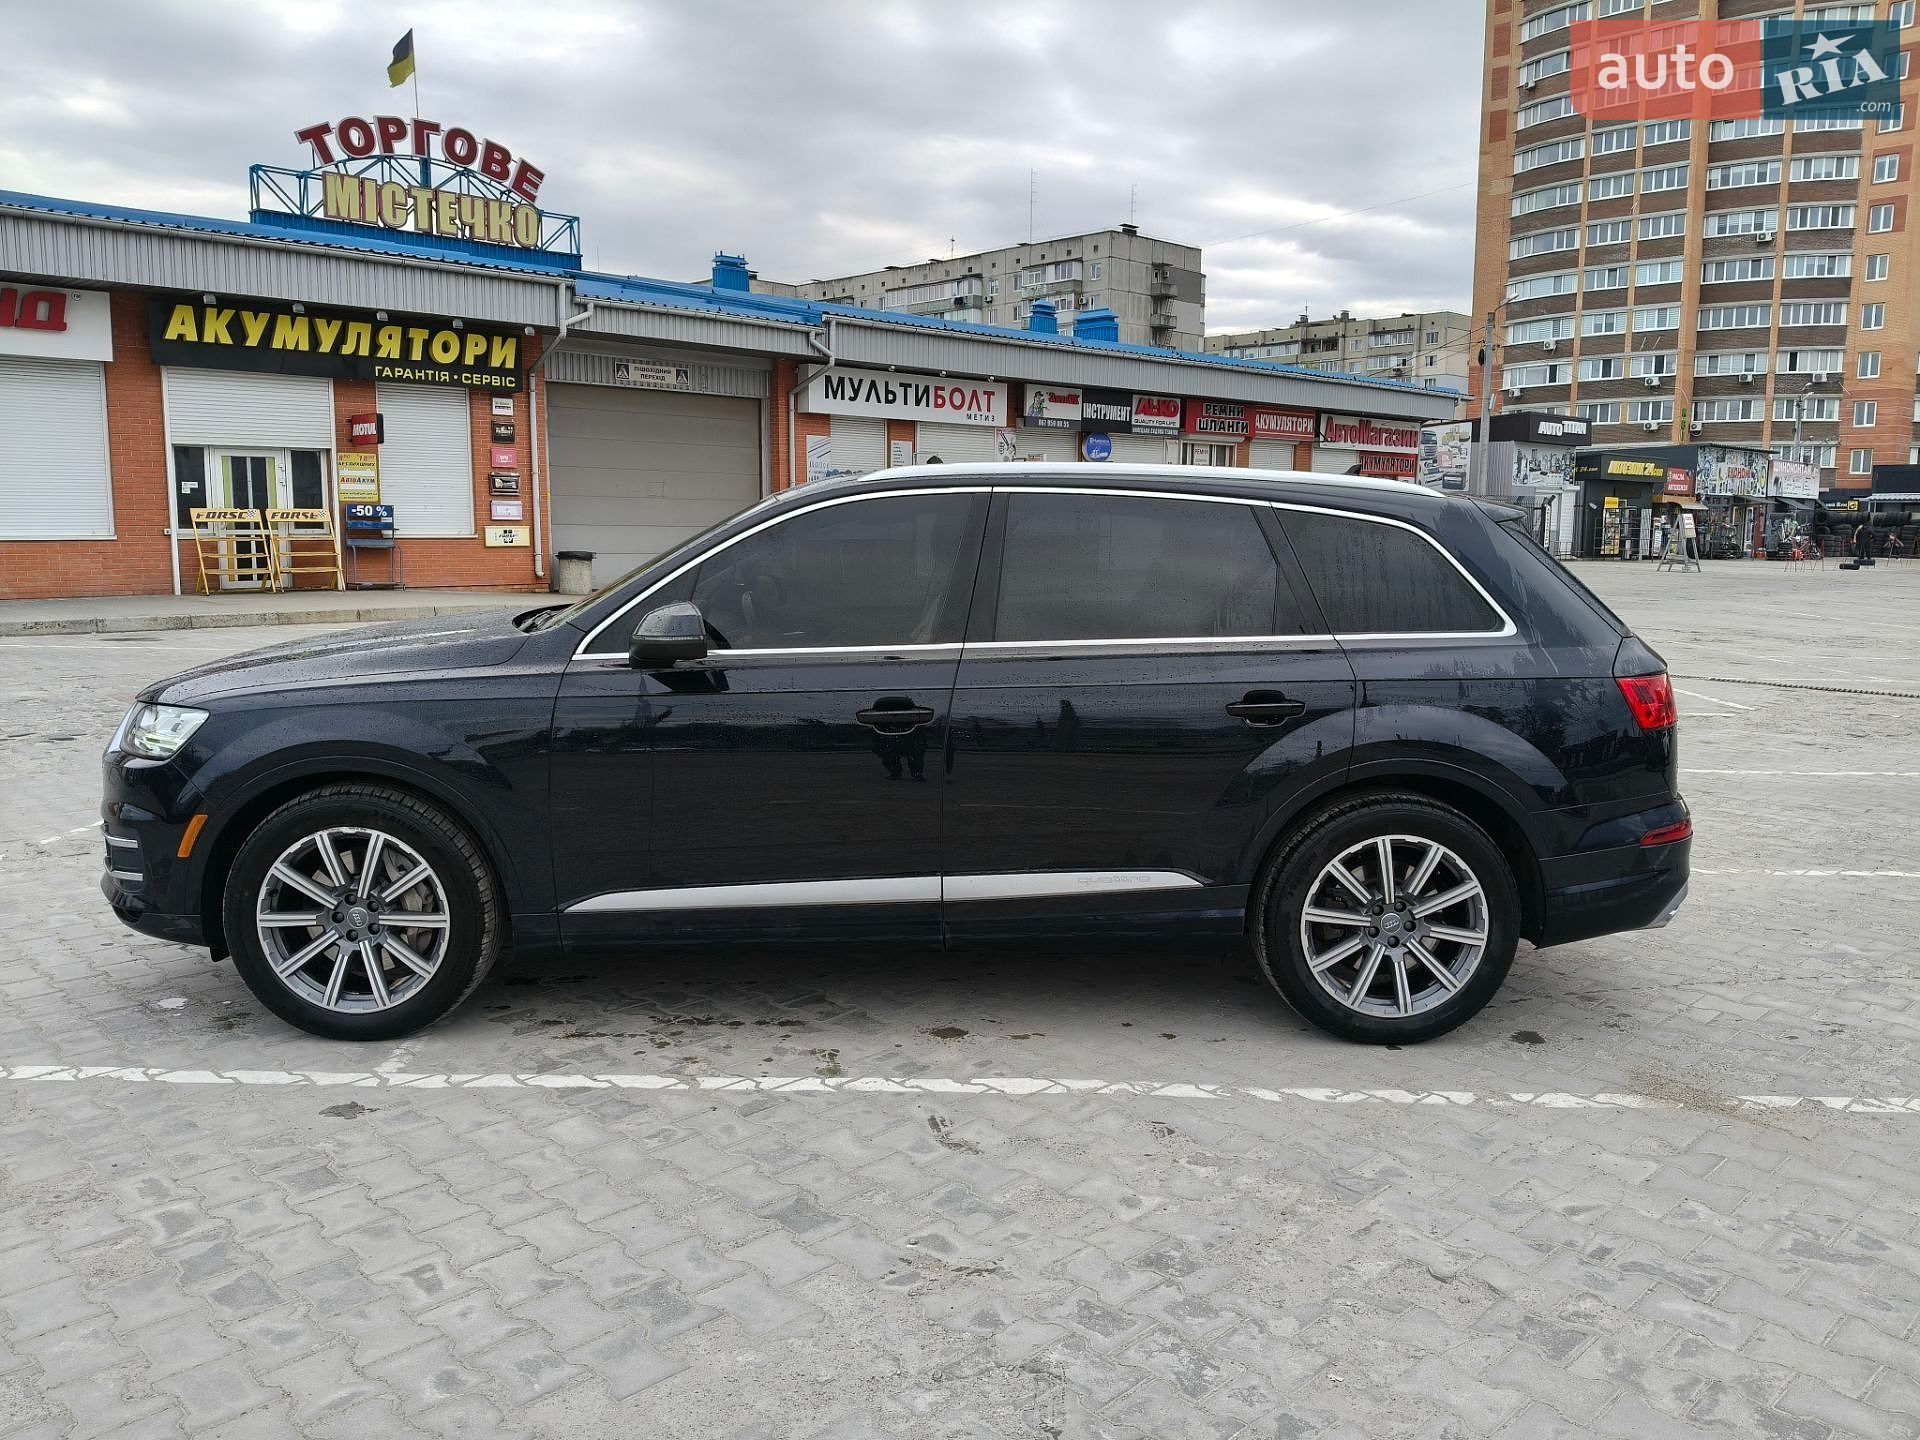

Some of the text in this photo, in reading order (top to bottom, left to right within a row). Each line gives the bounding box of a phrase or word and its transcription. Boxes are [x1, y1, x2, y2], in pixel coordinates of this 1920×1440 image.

[294, 115, 546, 203] ТОРГОВЕ
[322, 170, 541, 248] МІСТЕЧКО
[164, 305, 517, 369] АКУМУЛЯТОРИ
[375, 366, 516, 388] ГАРАНТІЯ СЕРВІС
[824, 374, 995, 413] МУЛЬТИБОЛТ
[967, 413, 996, 422] МЕТИЗ
[1083, 402, 1132, 421] ІНСТРУМЕНТ
[352, 422, 377, 436] MOTUL
[1197, 418, 1250, 434] ШЛАНГИ
[1255, 414, 1313, 433] АКУМУЛЯТОРИ
[351, 505, 387, 517] -50 %
